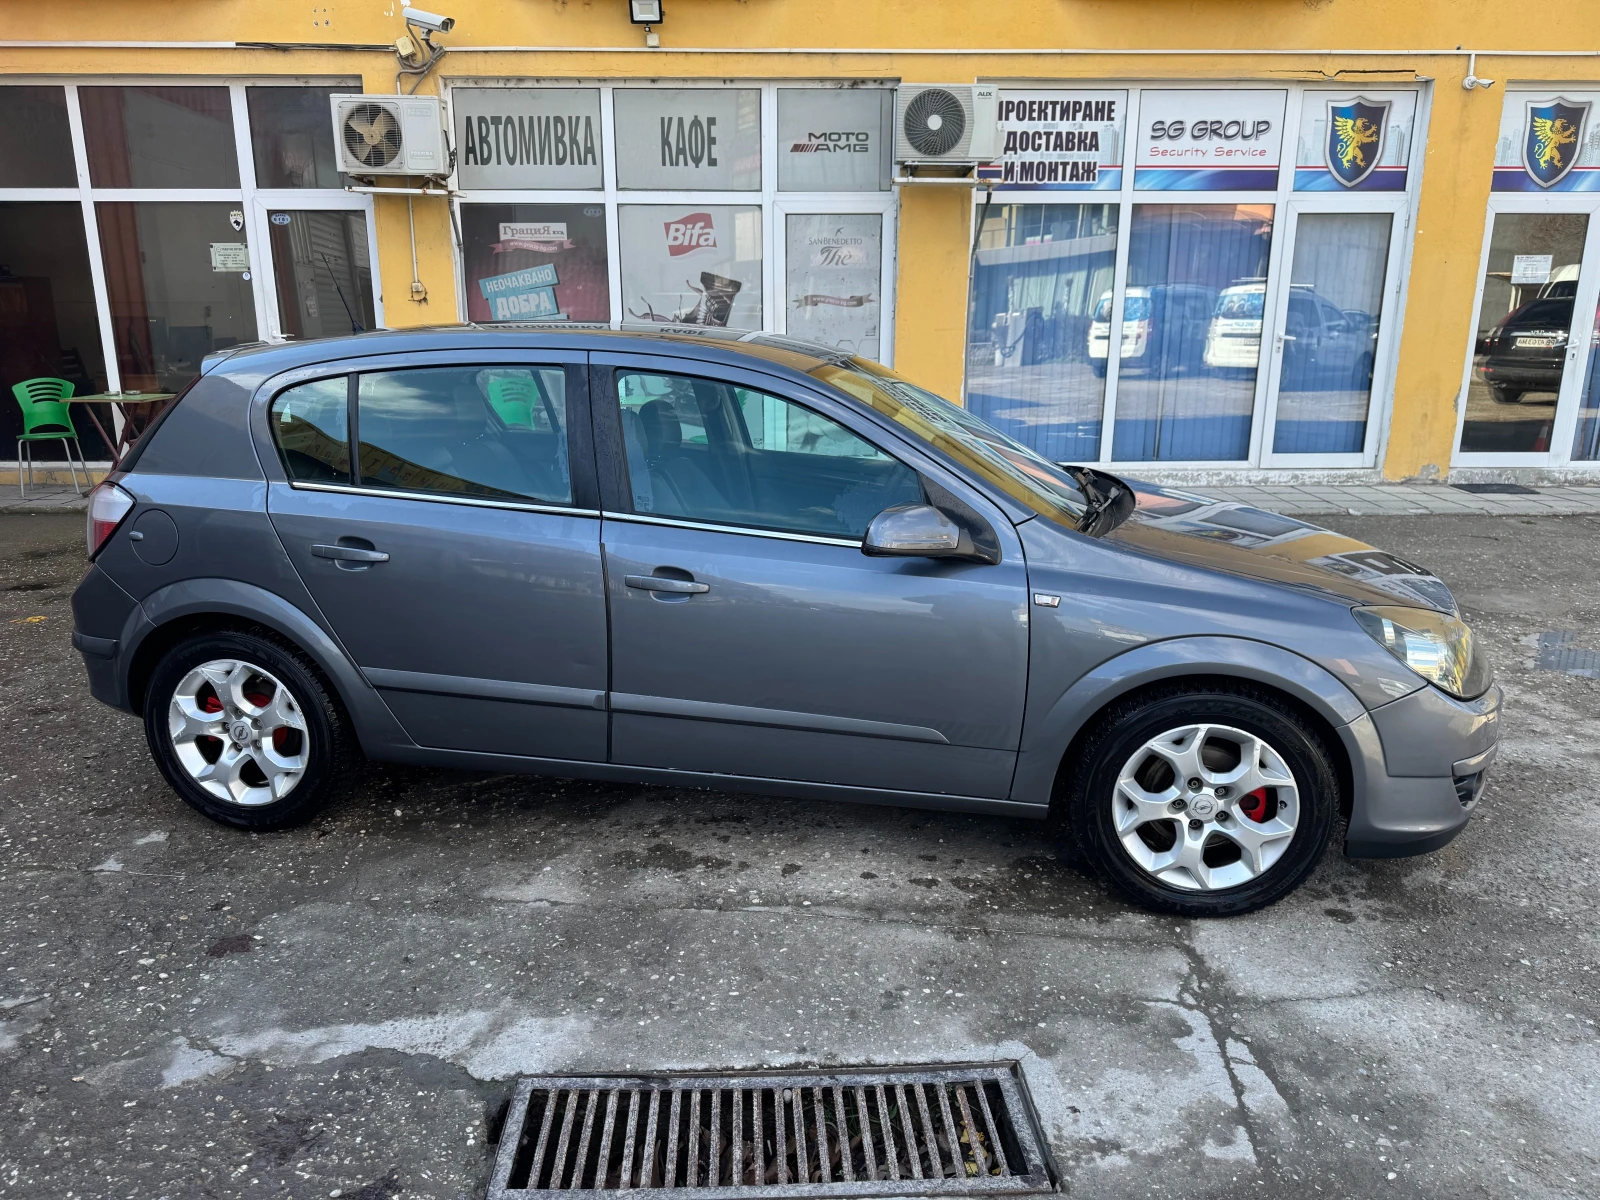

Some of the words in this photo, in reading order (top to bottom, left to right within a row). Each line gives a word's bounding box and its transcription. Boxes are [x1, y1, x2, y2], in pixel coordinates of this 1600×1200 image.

[464, 115, 597, 166] АВТОМИВКА
[660, 115, 718, 168] КАФЕ
[808, 132, 869, 142] MOTO
[1150, 120, 1186, 140] SG
[1191, 120, 1272, 140] GROUP
[813, 143, 869, 153] AMG
[1003, 130, 1100, 155] ДОСТАВКА
[1149, 146, 1208, 157] Security
[1214, 146, 1267, 157] Service
[1003, 161, 1015, 182] И
[1019, 161, 1097, 182] МОНТАЖ
[667, 222, 716, 246] Bifa
[485, 268, 553, 293] НЕОЧАКВАНО
[496, 291, 552, 319] ДОБРА
